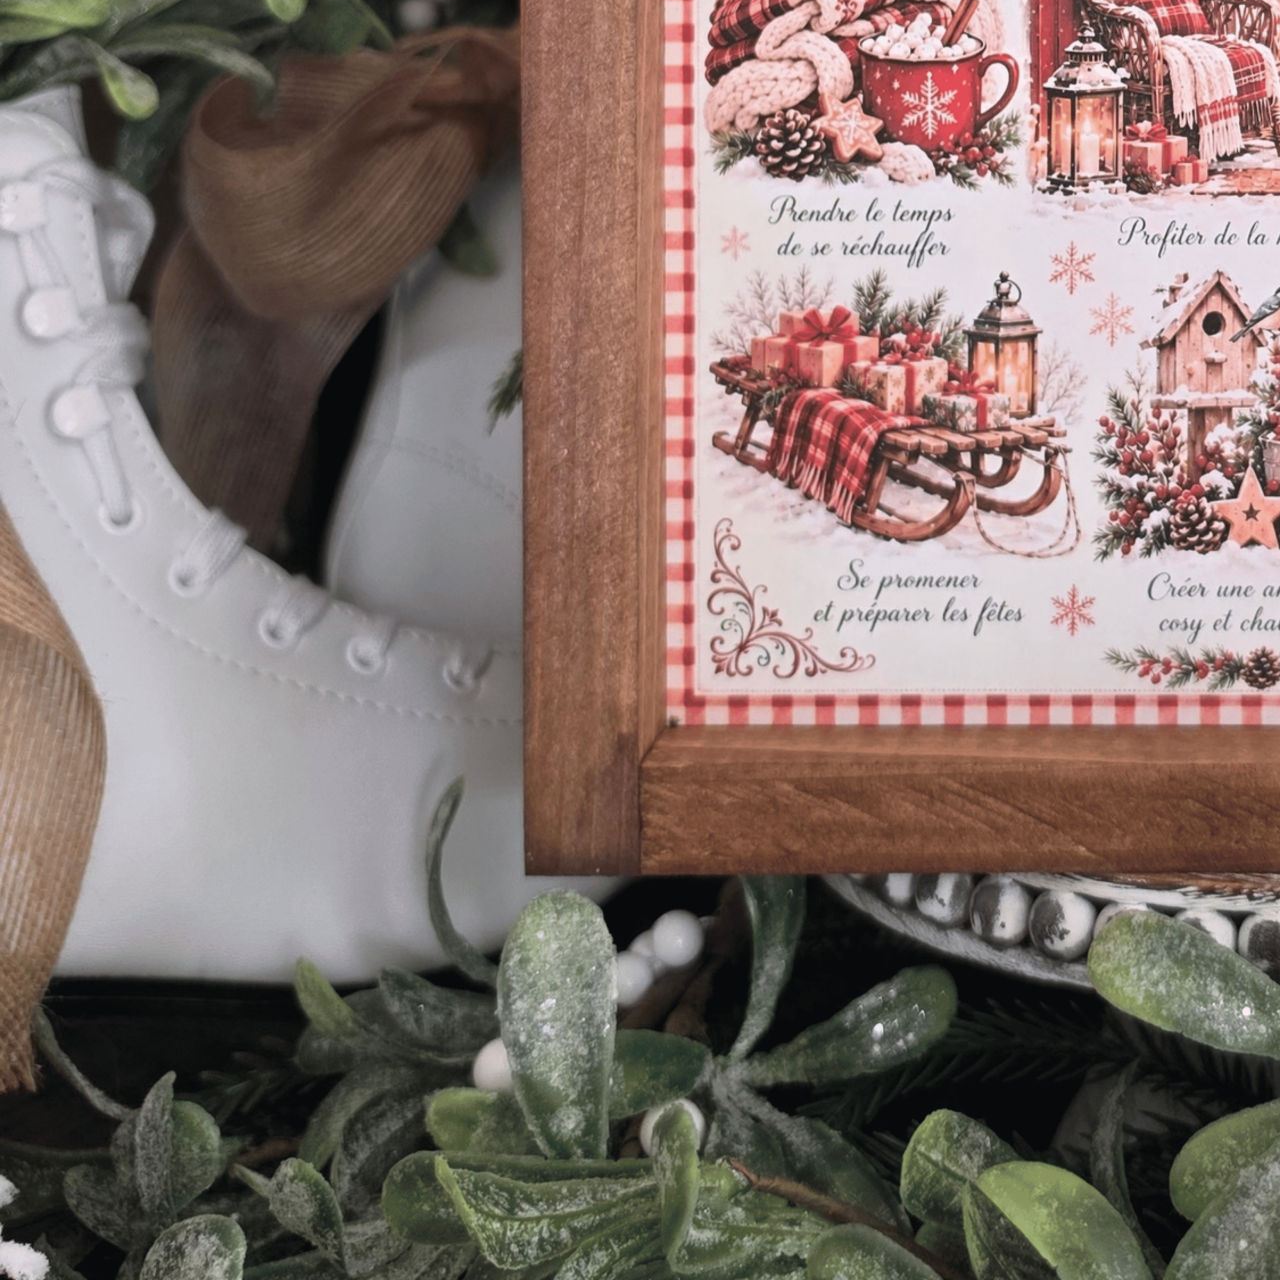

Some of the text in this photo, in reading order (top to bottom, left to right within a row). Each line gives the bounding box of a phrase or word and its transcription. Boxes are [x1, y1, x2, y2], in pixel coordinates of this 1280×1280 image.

[768, 195, 955, 234] Prendre le temps
[777, 230, 951, 268] de se réchauffer
[1117, 216, 1206, 259] Profiter
[1214, 221, 1239, 246] de
[1247, 220, 1269, 246] la
[836, 558, 982, 600] Se promener
[1147, 572, 1210, 601] Créer
[1216, 585, 1256, 598] une
[813, 596, 1026, 636] et préparer les fêtes
[1158, 616, 1205, 644] cosy
[1212, 609, 1234, 632] et
